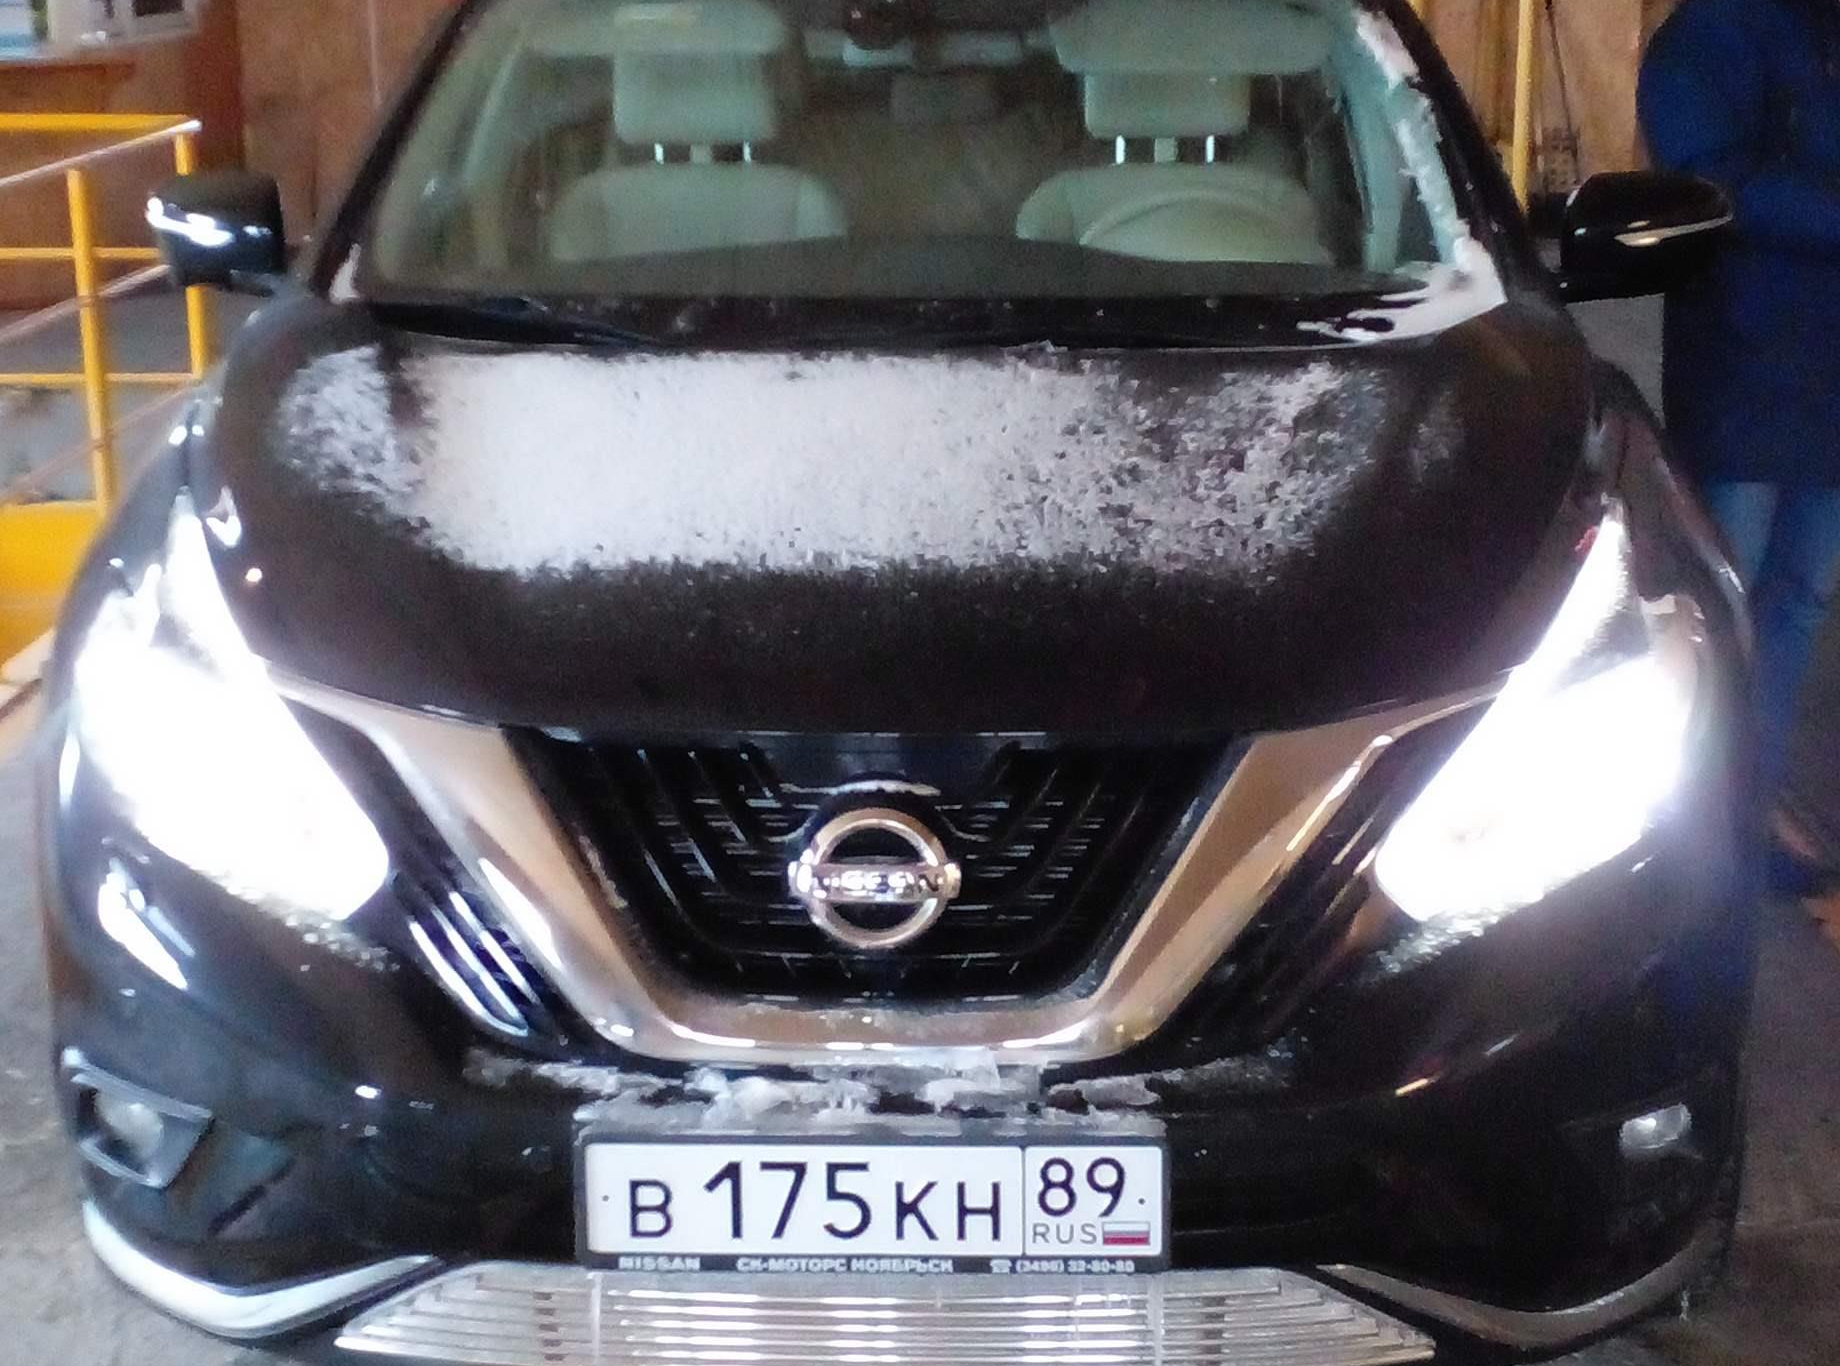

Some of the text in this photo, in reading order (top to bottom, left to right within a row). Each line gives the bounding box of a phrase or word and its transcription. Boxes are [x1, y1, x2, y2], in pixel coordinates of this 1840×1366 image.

[1038, 1157, 1125, 1217] 89
[1032, 1222, 1097, 1244] RUS
[618, 1256, 700, 1271] NISSAN
